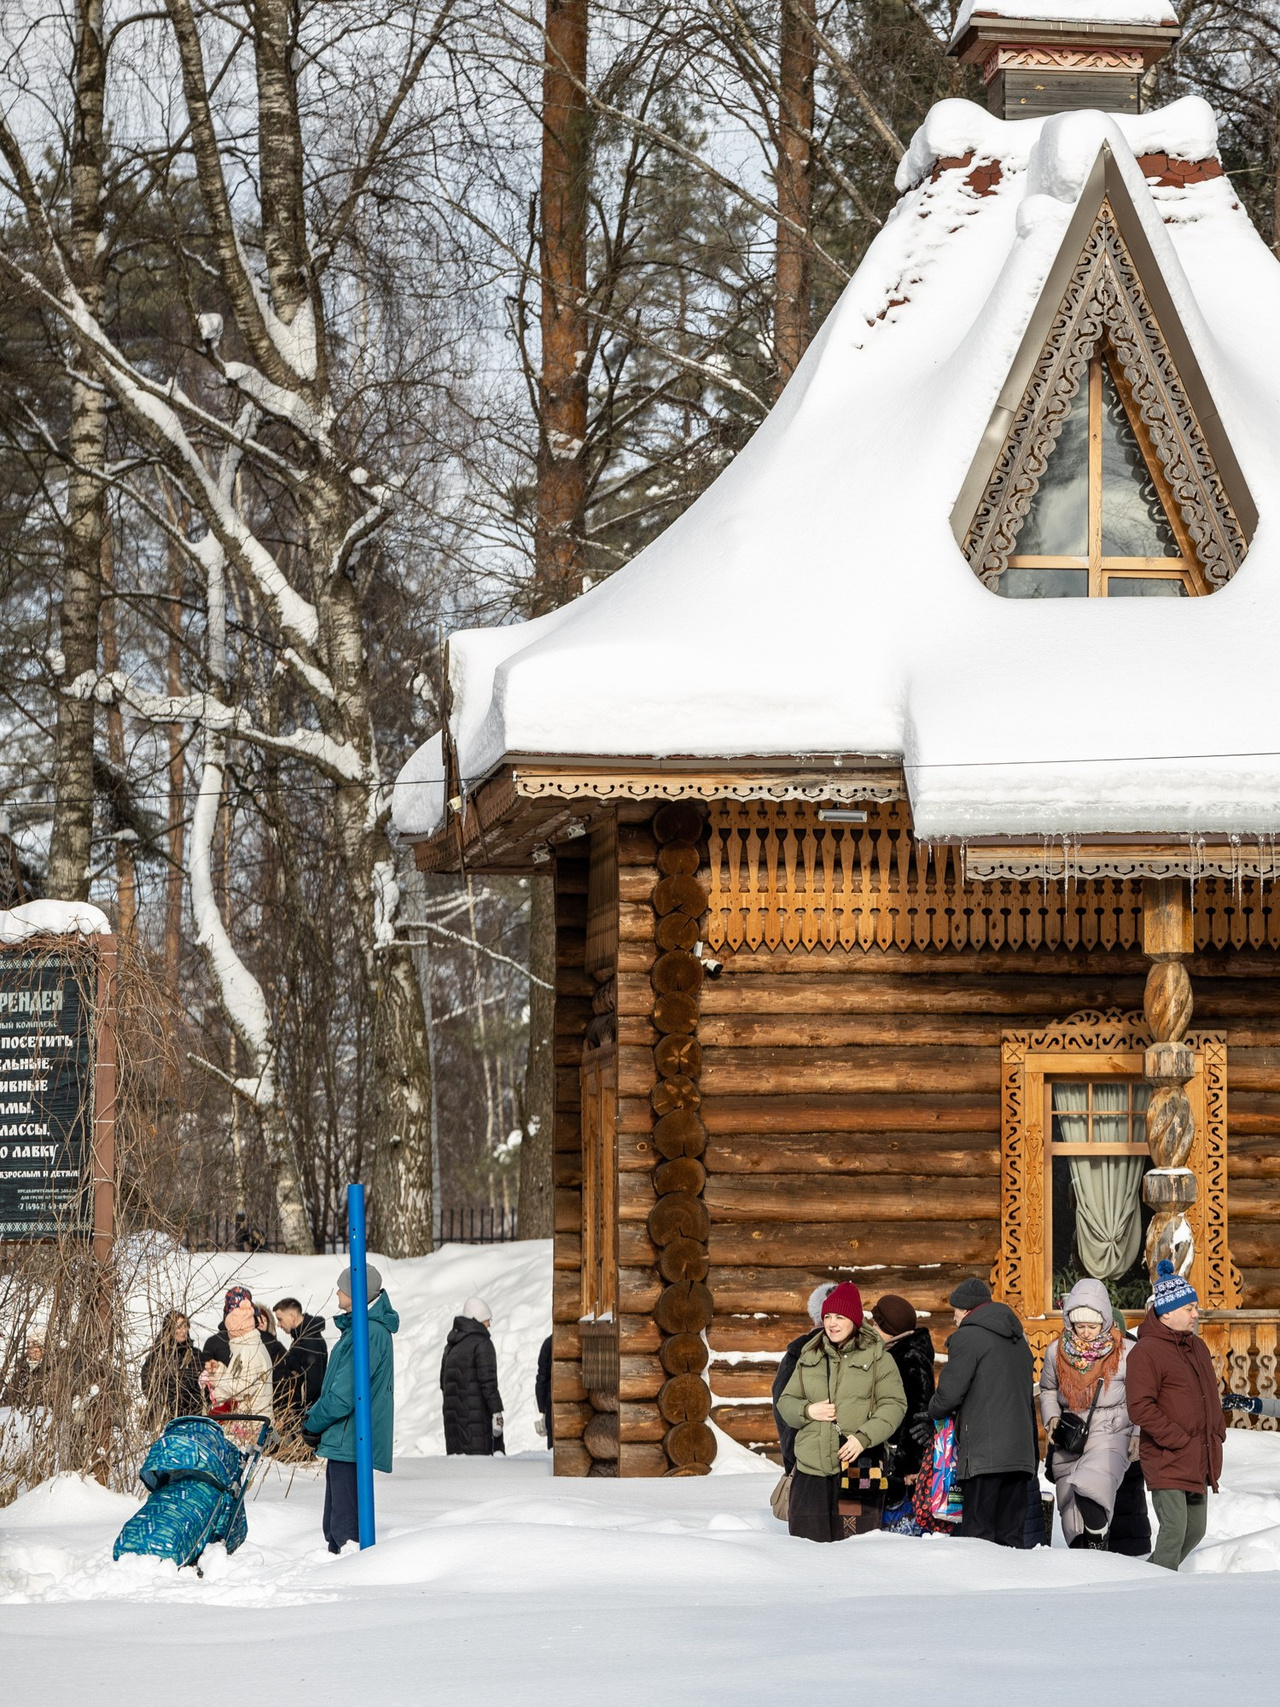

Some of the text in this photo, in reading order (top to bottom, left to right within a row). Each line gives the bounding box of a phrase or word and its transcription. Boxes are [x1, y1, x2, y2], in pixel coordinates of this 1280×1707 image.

[1, 1035, 73, 1049] ПОСЕТИТЬ
[12, 1144, 59, 1165] ЛАВКУ
[43, 1170, 49, 1178] И
